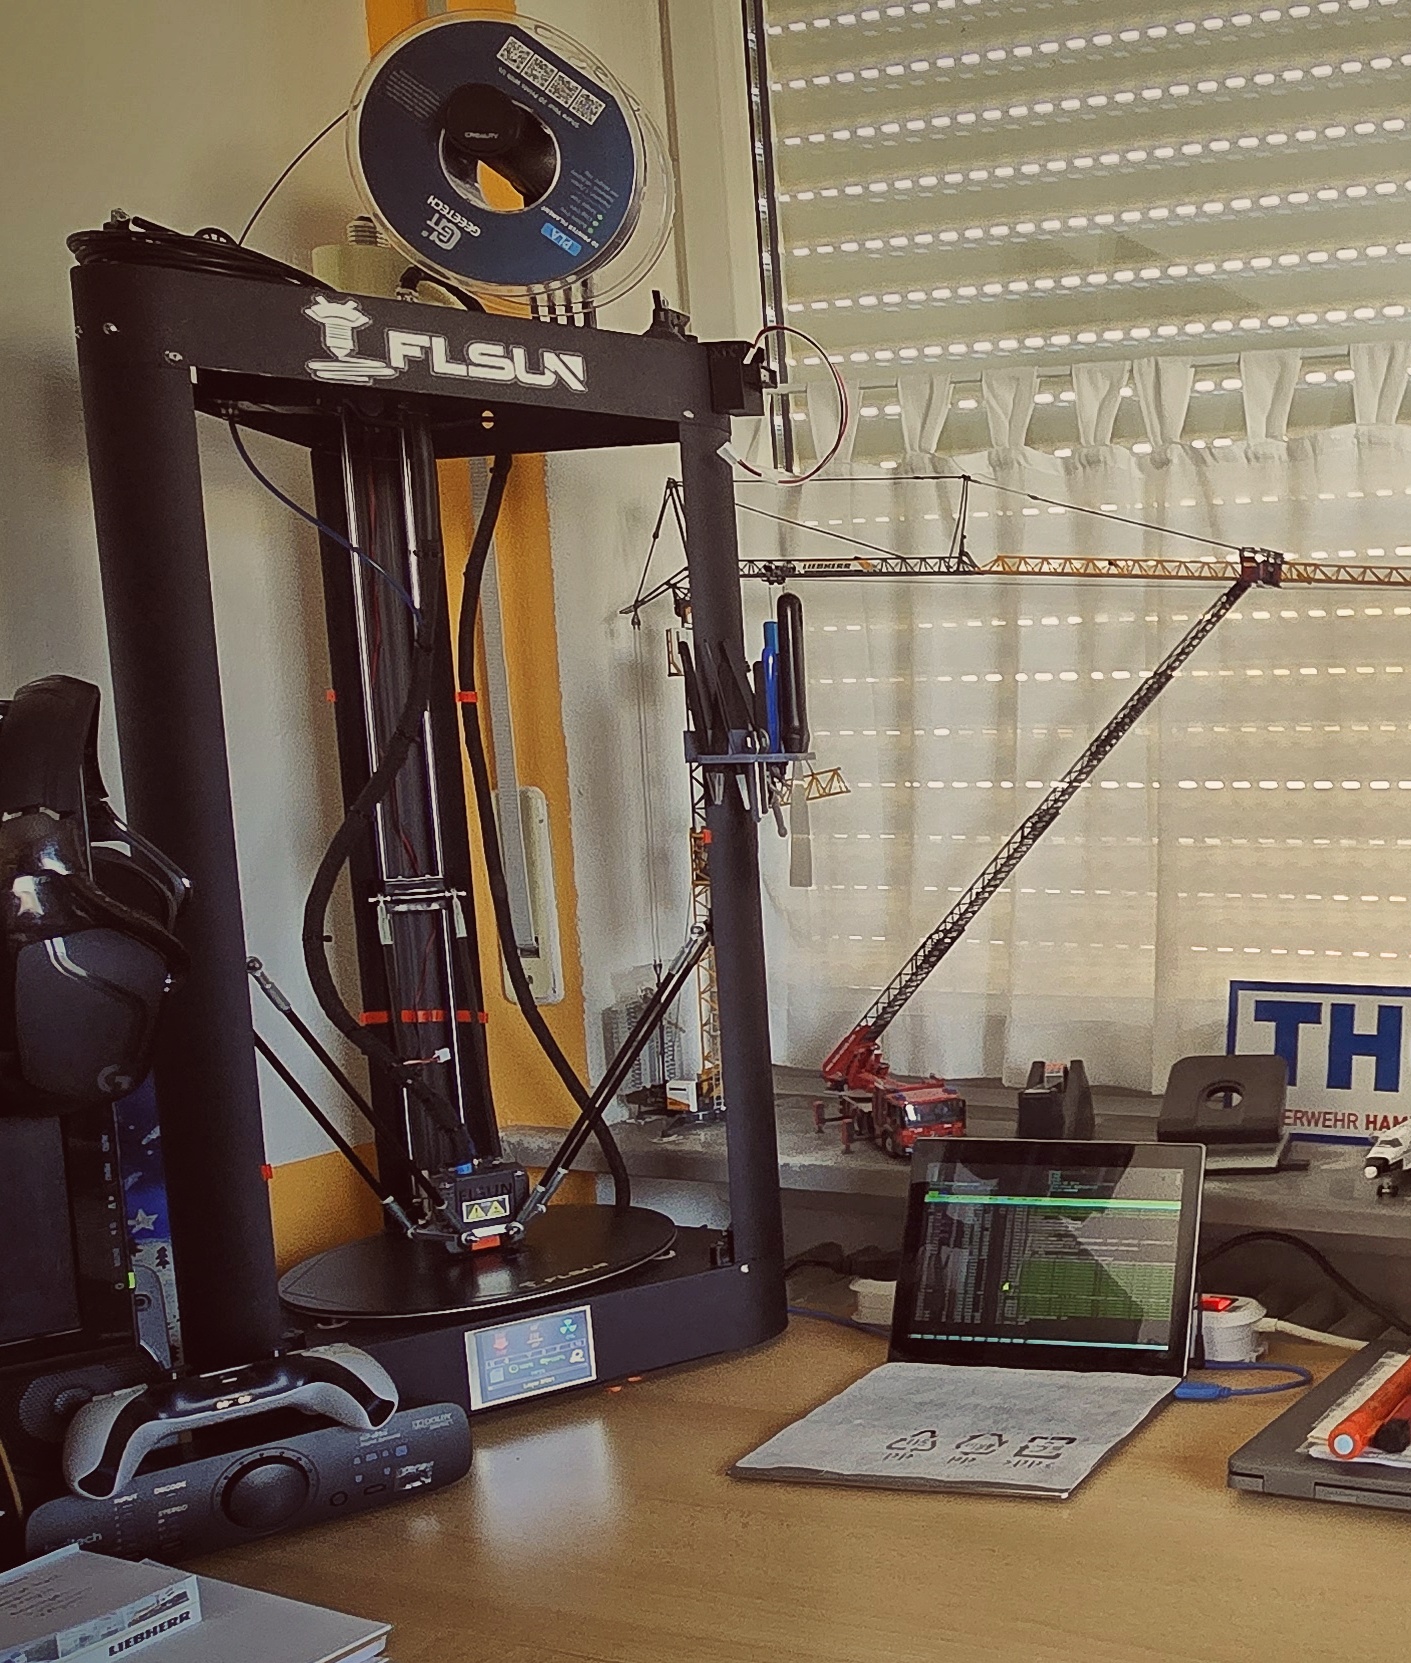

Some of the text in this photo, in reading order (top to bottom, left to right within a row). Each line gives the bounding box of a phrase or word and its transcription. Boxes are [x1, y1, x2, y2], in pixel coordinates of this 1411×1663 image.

[427, 195, 481, 237] GEEETECH
[551, 228, 573, 251] PLA
[387, 331, 588, 393] FLSUN
[1283, 1108, 1359, 1130] ERWEHR
[108, 1610, 191, 1657] LIEBHERR
